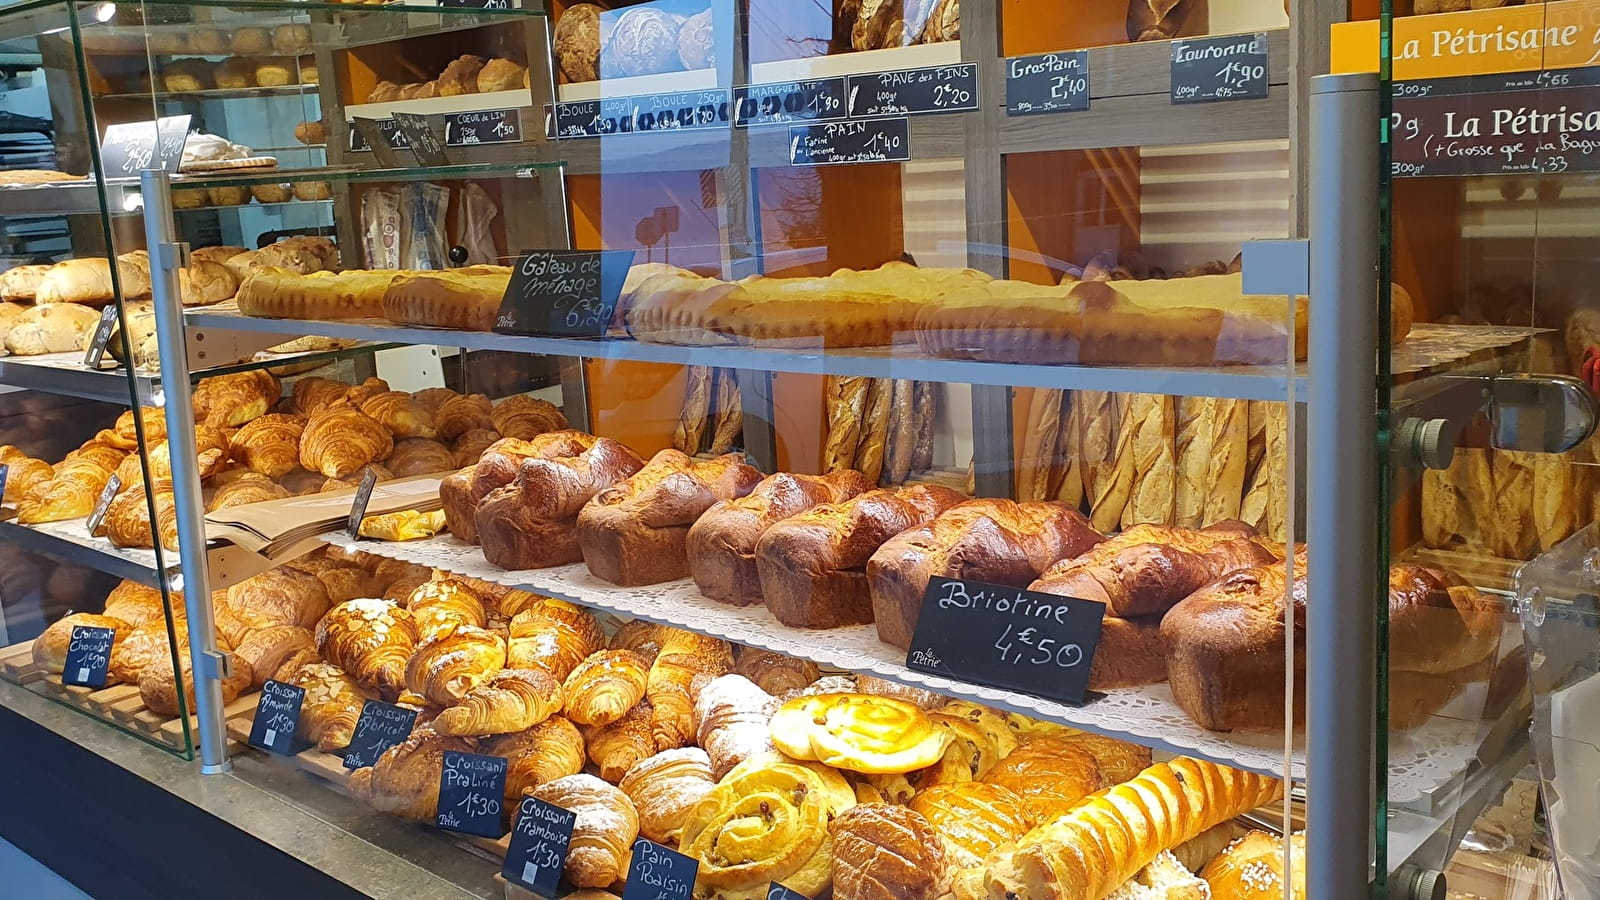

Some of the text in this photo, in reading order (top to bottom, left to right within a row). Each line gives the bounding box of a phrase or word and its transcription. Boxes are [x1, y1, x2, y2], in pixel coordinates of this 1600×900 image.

[1175, 40, 1259, 63] Couronne
[1431, 24, 1578, 57] Pétrisane
[934, 66, 969, 80] FINS
[752, 82, 816, 97] MARGUERITE
[558, 103, 594, 119] BOULE
[651, 94, 687, 111] BOULE
[824, 122, 866, 138] PAIN
[1444, 112, 1481, 138] La
[1500, 142, 1526, 162] que
[521, 252, 601, 276] Gâteau de
[522, 275, 597, 301] ménage
[938, 581, 1069, 625] Briotine
[912, 650, 942, 668] Pétrie
[263, 680, 303, 700] Croissant
[362, 702, 416, 723] Croissant
[358, 716, 406, 738] Abricot
[445, 756, 507, 773] Croissant
[443, 768, 498, 790] Praliné
[521, 797, 573, 825] Croissant
[516, 816, 568, 846] Framboise
[635, 839, 673, 869] Pain
[636, 861, 688, 897] Raisin
